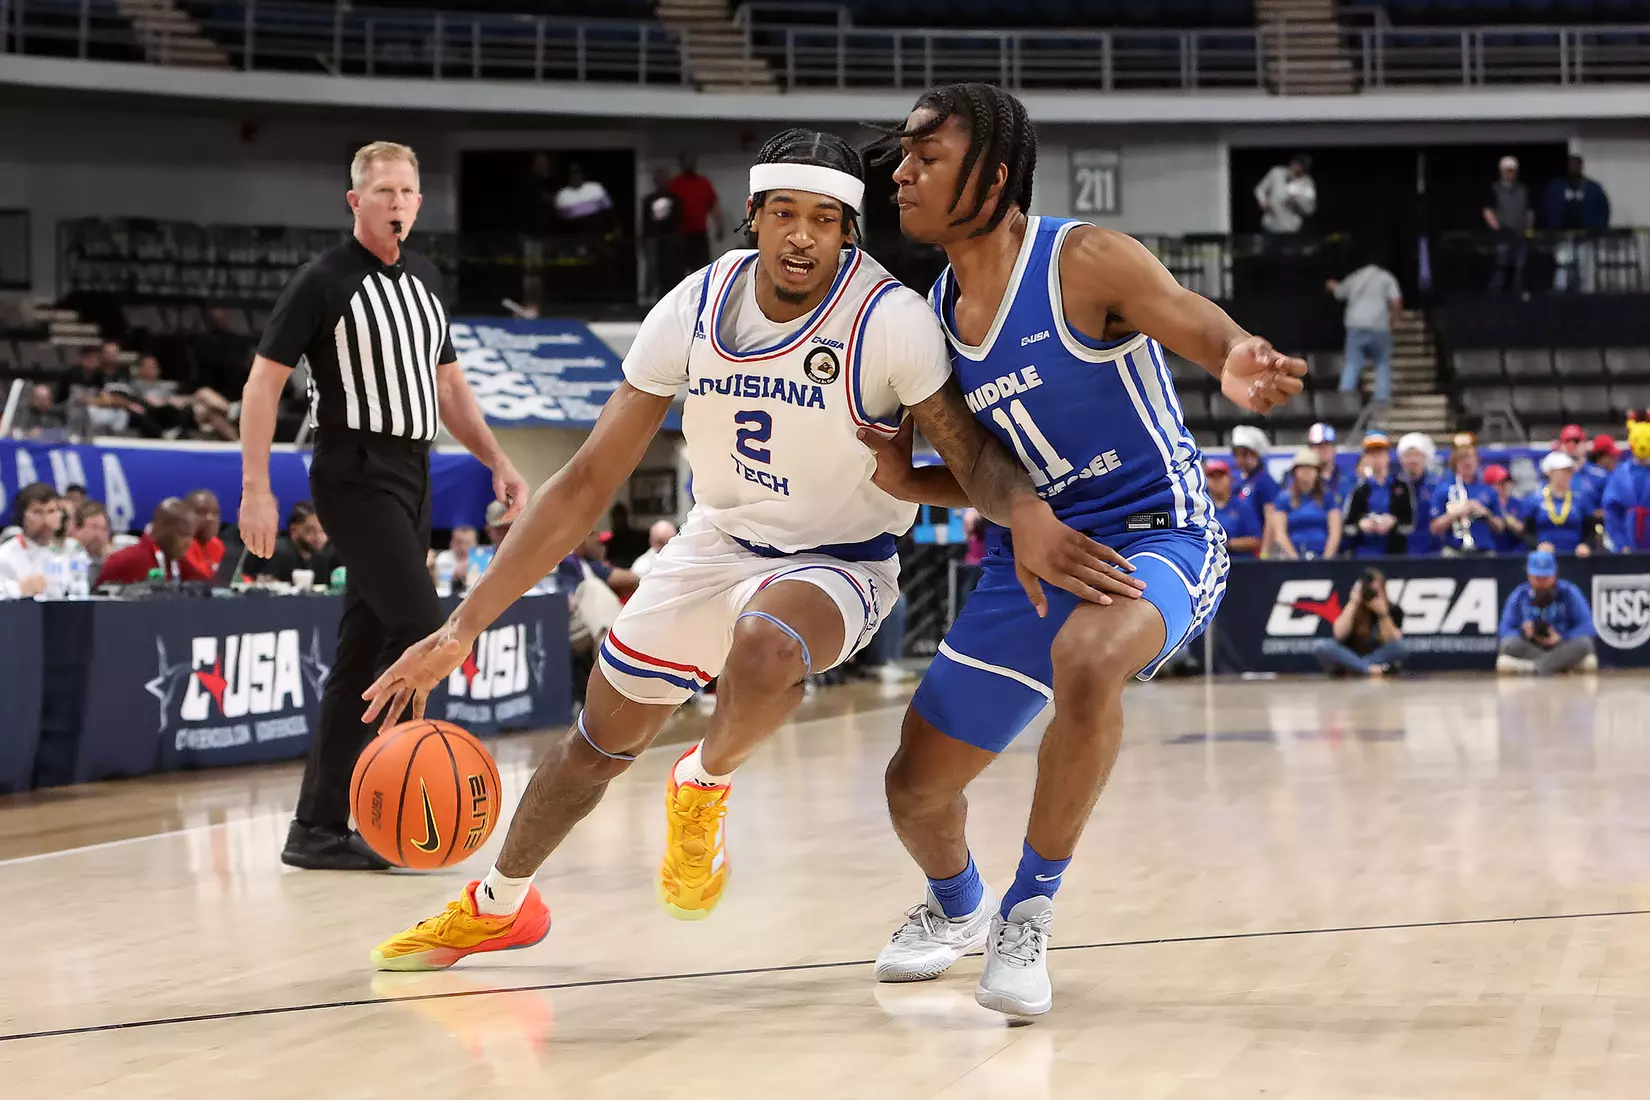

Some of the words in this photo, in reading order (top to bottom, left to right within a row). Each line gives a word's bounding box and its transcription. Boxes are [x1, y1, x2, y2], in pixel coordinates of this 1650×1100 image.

[1075, 168, 1114, 210] 211
[964, 365, 1044, 414] MIDDLE
[734, 410, 772, 464] 2
[992, 399, 1075, 487] 11
[730, 453, 789, 496] TECH
[1156, 517, 1165, 526] M
[1265, 578, 1498, 635] CSA
[1601, 589, 1650, 627] HSC
[463, 774, 489, 851] ELITE
